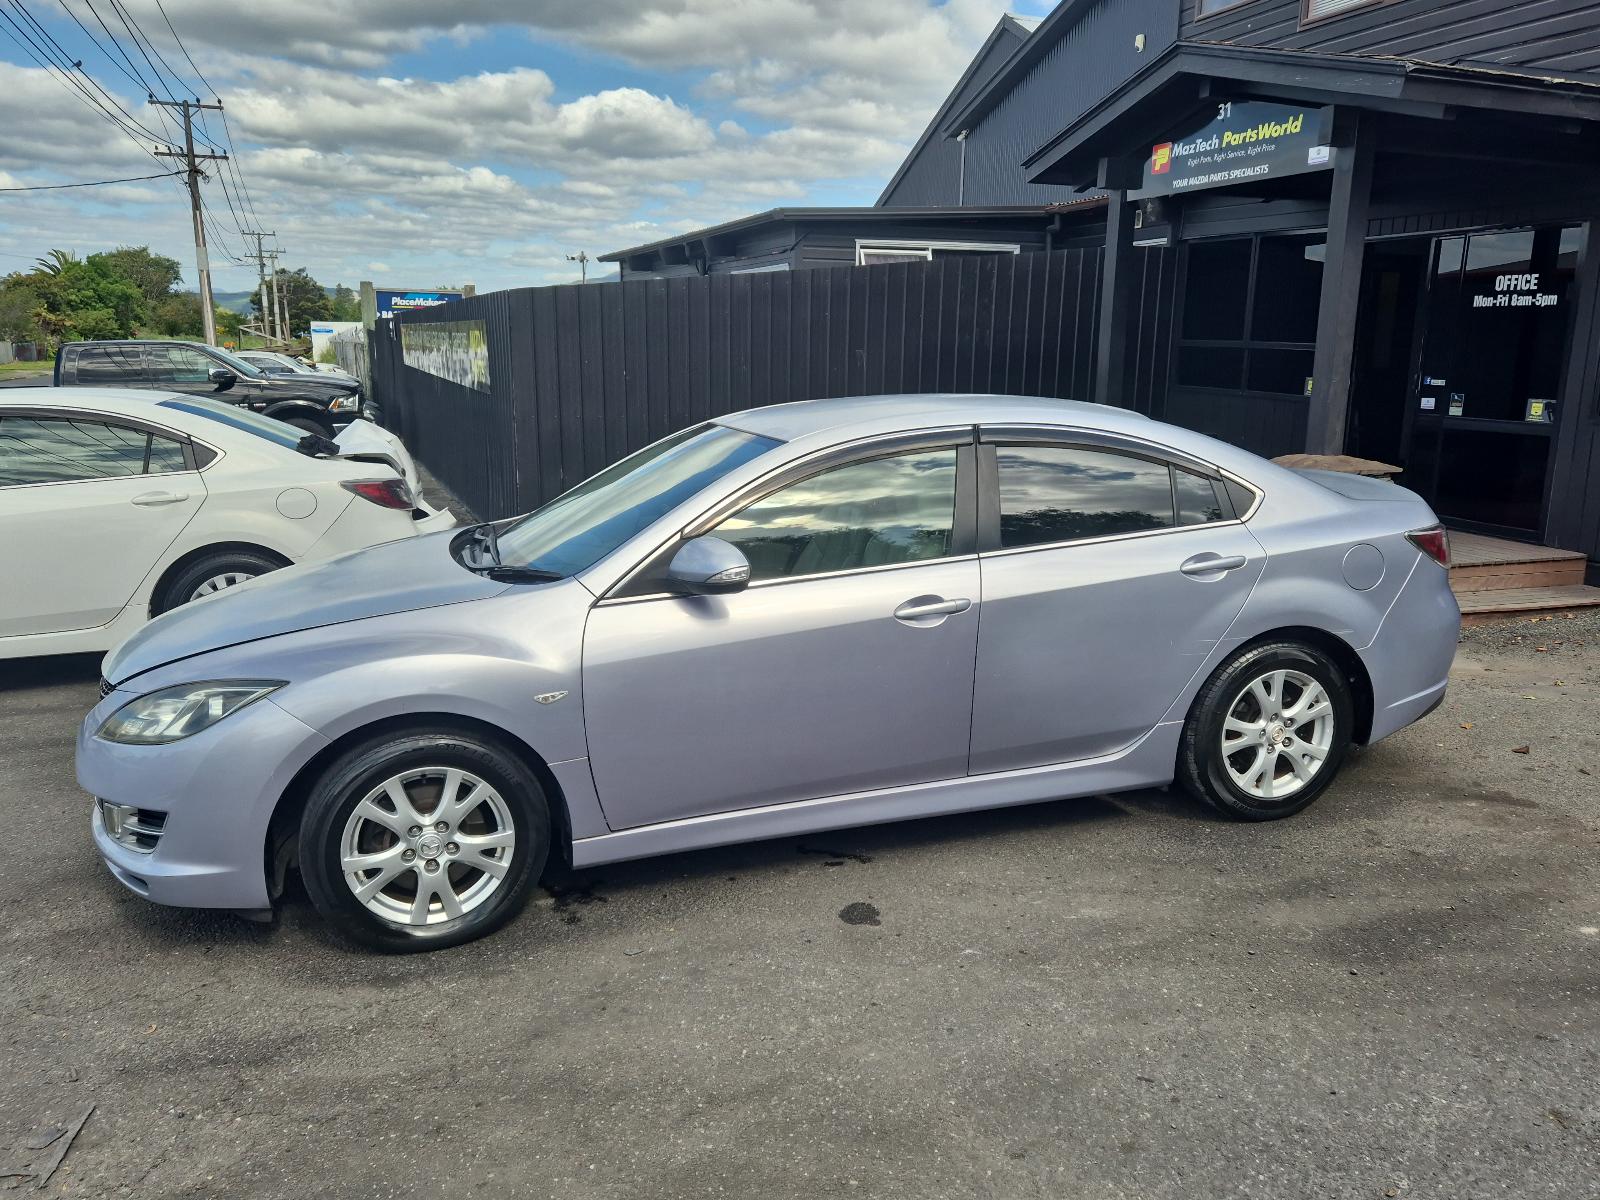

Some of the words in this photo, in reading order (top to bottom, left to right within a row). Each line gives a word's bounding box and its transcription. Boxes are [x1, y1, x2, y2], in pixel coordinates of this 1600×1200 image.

[1217, 101, 1232, 120] 31
[1172, 134, 1219, 157] MazTech
[1222, 114, 1304, 148] PartsWorld
[1213, 152, 1227, 163] Right
[1247, 144, 1261, 156] Right
[1172, 177, 1188, 189] YOUR
[1188, 174, 1209, 186] MAZDA
[1209, 171, 1230, 182] PARTS
[1229, 164, 1269, 180] SPECIALISTS
[1495, 273, 1539, 291] OFFICE
[1473, 293, 1509, 308] Mon-Fri
[1511, 293, 1558, 307] 8am-5pm
